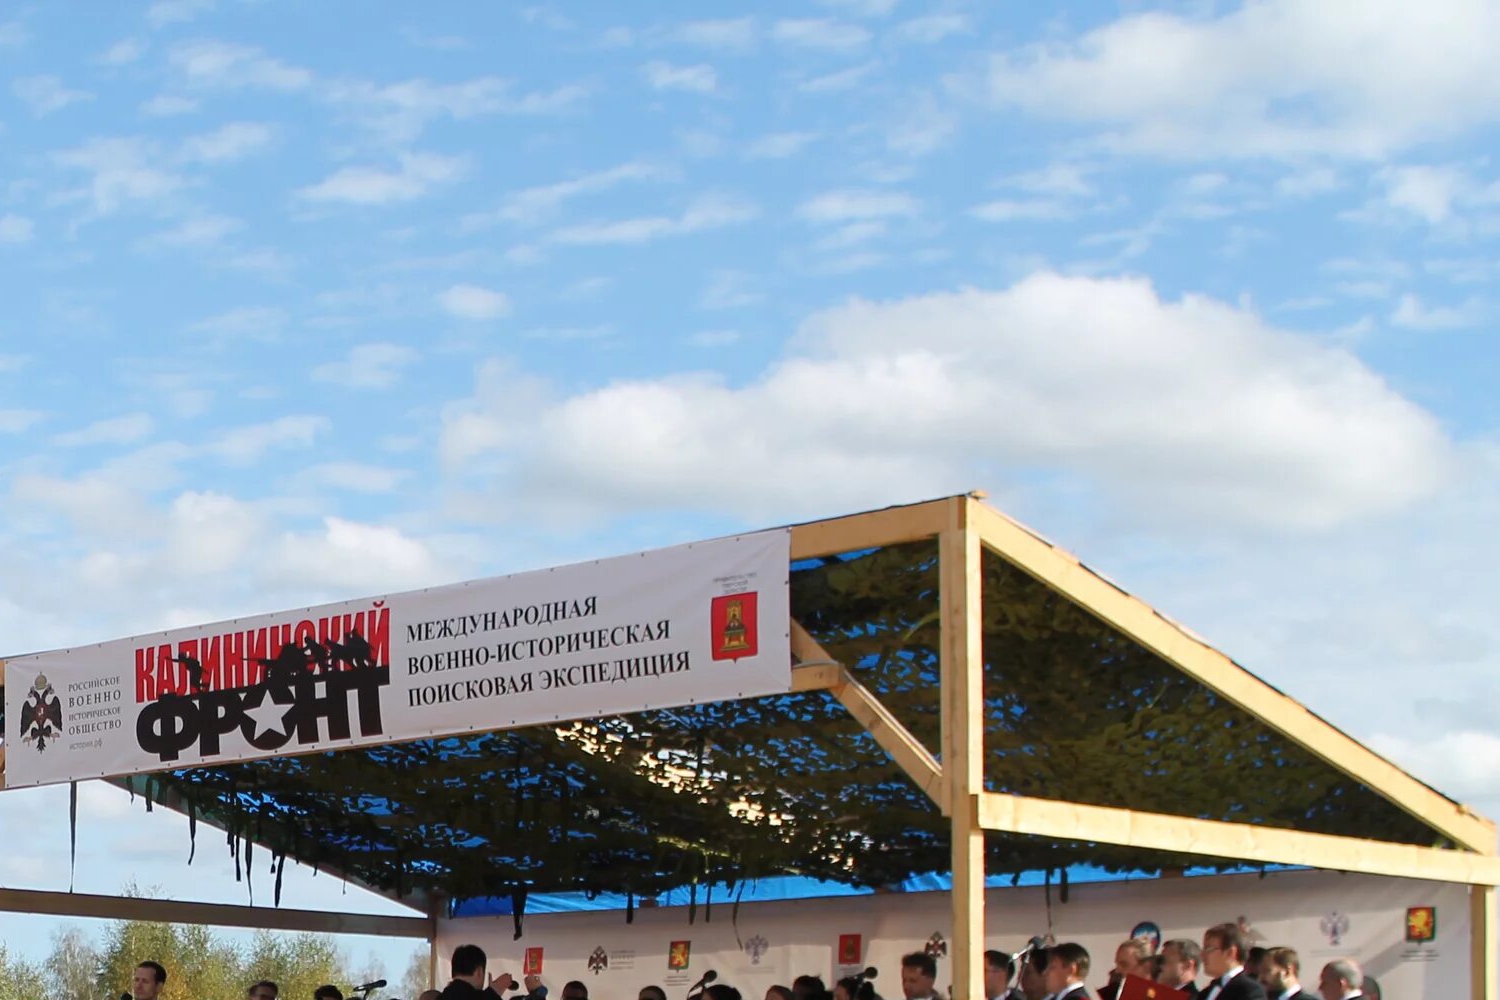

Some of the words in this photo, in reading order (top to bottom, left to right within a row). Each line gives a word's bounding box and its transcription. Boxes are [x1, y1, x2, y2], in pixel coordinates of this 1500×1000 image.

[406, 596, 598, 643] МЕЖДУНАРОДНАЯ
[408, 619, 671, 676] ВОЕННО-ИСТОРИЧЕСКАЯ
[68, 676, 121, 692] РОССИЙСКОЕ
[68, 689, 121, 708] ВОЕННО
[408, 672, 533, 707] ПОИСКОВАЯ
[539, 650, 691, 690] ЭКСПЕДИЦИЯ
[68, 719, 122, 736] ОБЩЕСТВО
[136, 664, 390, 763] ФРОНТ
